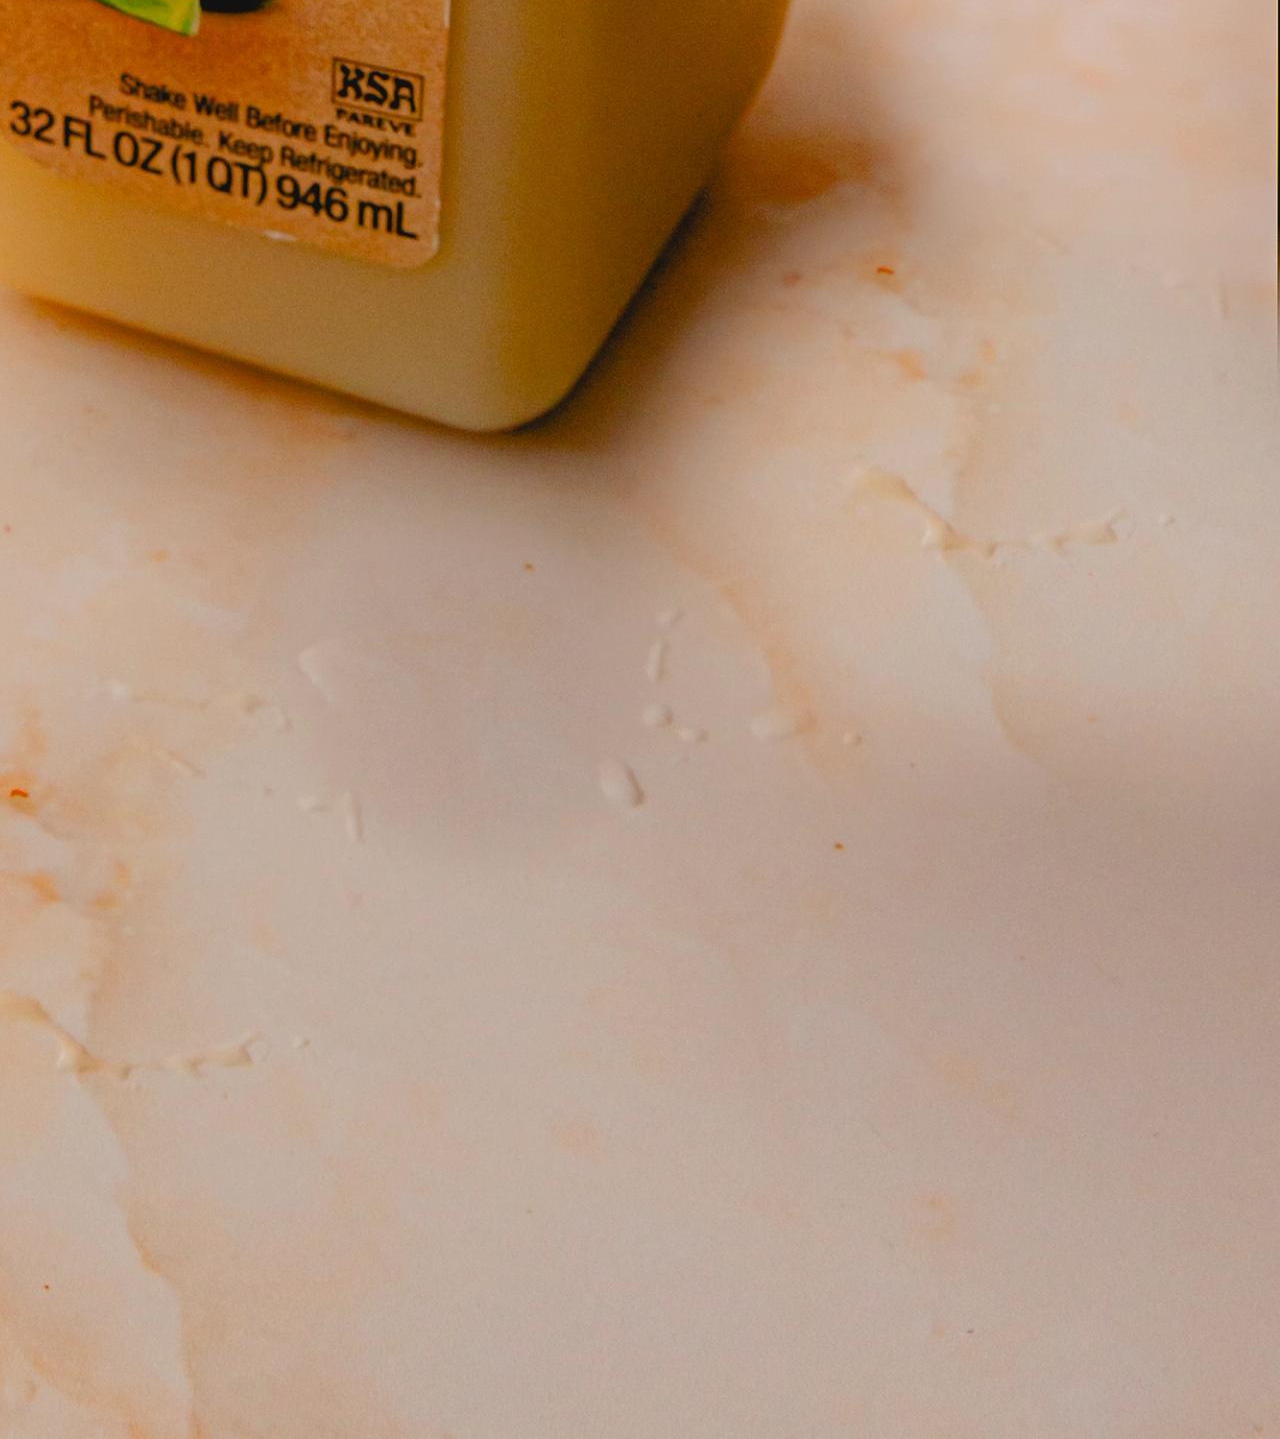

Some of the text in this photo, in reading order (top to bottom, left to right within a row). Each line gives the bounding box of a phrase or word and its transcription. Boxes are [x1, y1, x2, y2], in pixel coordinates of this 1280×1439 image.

[119, 72, 423, 170] Shake Well Before Enjoying.
[336, 107, 416, 137] PAREVE
[337, 64, 417, 113] KSA
[9, 99, 419, 241] 32 FL OZ (1 QT) 946 mL
[88, 93, 422, 199] Perishable. Keep Refrigerated.
